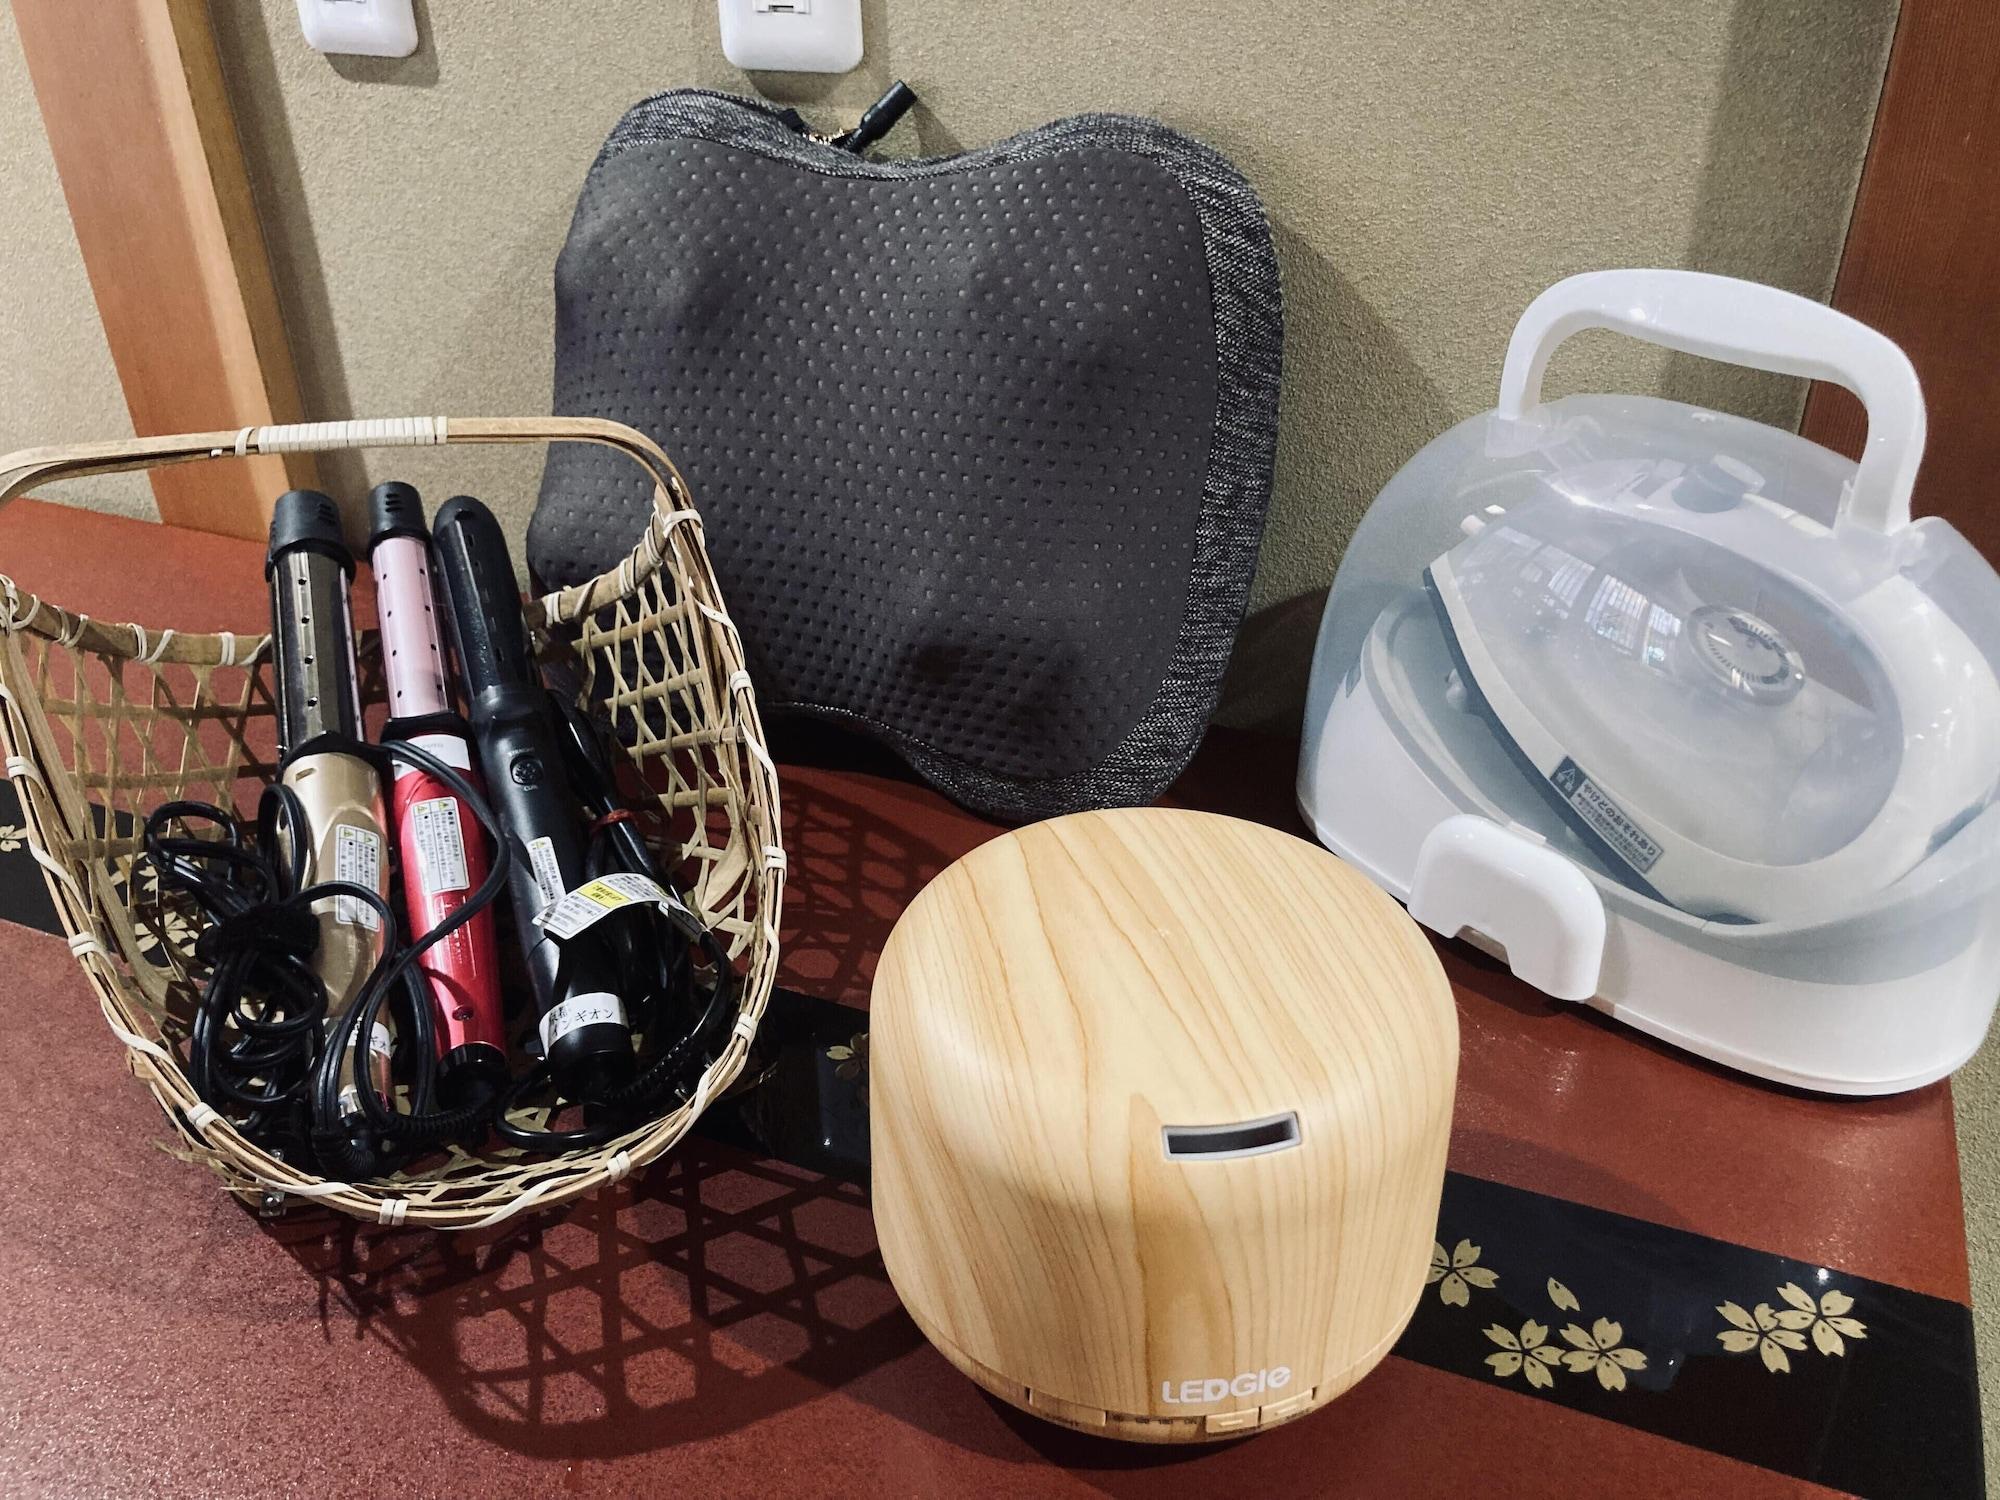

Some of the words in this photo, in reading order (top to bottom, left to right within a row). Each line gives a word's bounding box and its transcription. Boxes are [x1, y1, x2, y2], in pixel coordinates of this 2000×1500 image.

[1583, 783, 1656, 856] やけどのおそれあり
